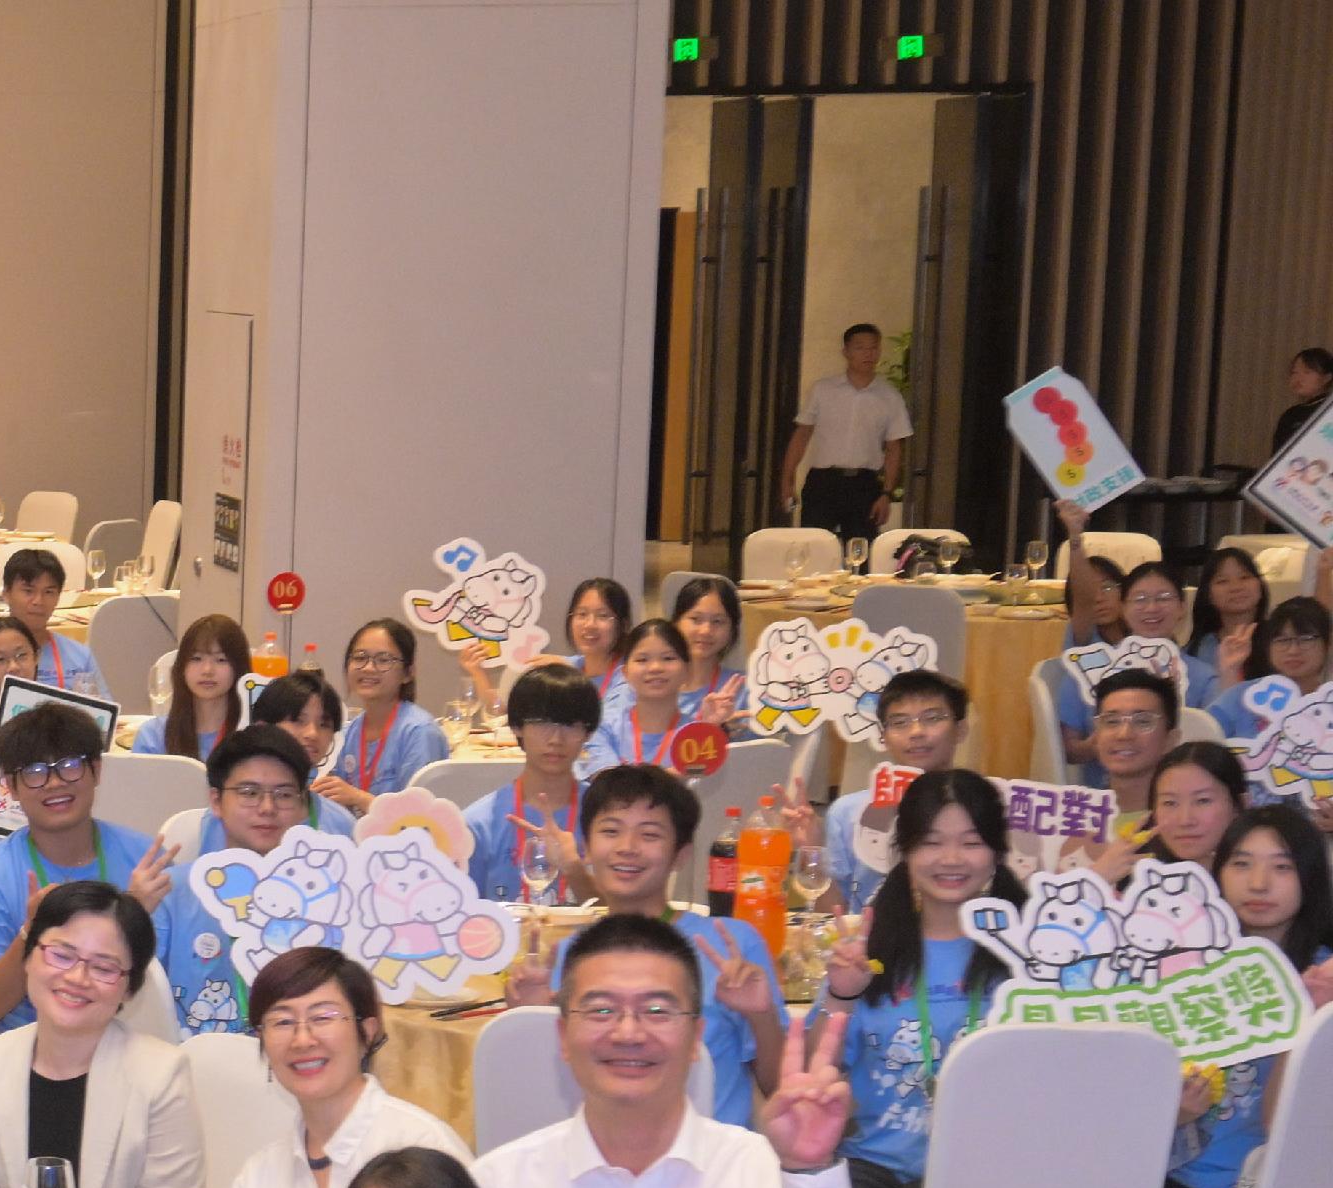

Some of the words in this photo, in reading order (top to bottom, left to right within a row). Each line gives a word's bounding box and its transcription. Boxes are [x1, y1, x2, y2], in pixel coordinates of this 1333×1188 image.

[273, 579, 299, 598] 06
[682, 736, 718, 763] 04
[1009, 785, 1115, 844] 配對
